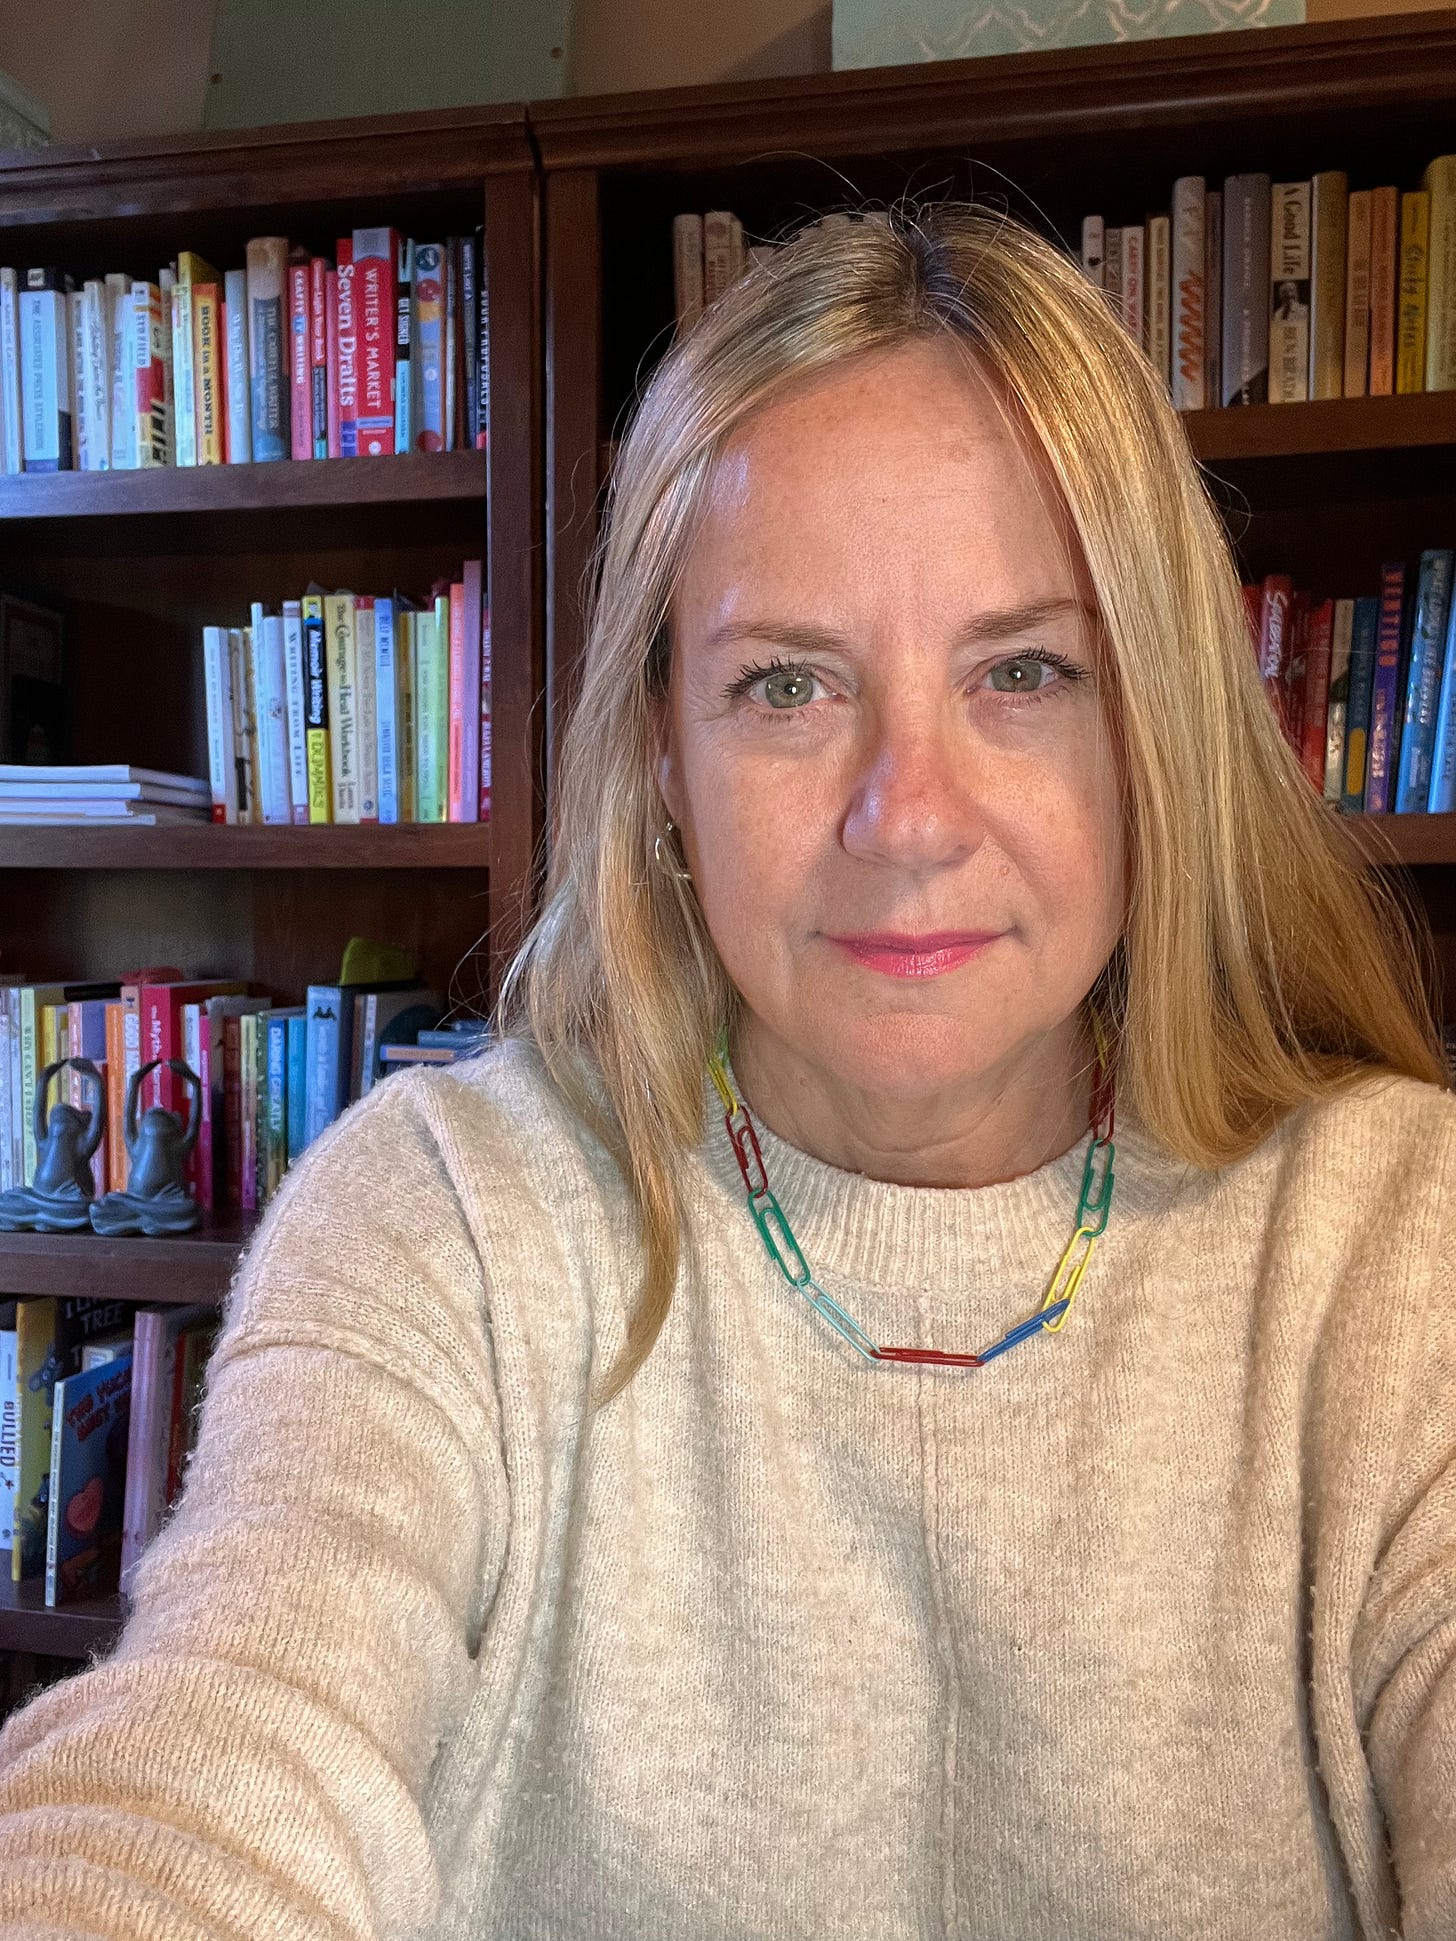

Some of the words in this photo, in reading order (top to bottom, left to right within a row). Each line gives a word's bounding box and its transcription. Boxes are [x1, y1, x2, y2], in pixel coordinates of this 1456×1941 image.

[1283, 200, 1302, 241] Good
[1282, 245, 1301, 275] Life
[295, 270, 305, 313] CRAFTY
[337, 264, 355, 329] Seven
[365, 268, 379, 341] WRITER'S
[398, 298, 410, 313] GET
[201, 306, 211, 347] BOOK
[202, 350, 211, 363] in
[295, 334, 306, 384] WRITING
[338, 336, 358, 406] Drafts
[366, 347, 381, 408] MARKET
[203, 378, 214, 435] MONTH
[336, 603, 347, 623] The
[288, 632, 300, 693] WRITING
[310, 629, 323, 676] Memoir
[334, 624, 351, 673] Courage
[291, 701, 301, 739] FROM
[308, 679, 323, 724] Writing
[336, 685, 352, 715] Heal
[293, 745, 304, 778] LIFE
[337, 716, 353, 777] Workbook
[311, 741, 325, 808] DUMMIES
[149, 1020, 162, 1051] Myth
[271, 1027, 282, 1075] DARING
[271, 1077, 282, 1131] GREATLY
[80, 1302, 126, 1334] TREE
[1, 1400, 15, 1468] BULLIED
